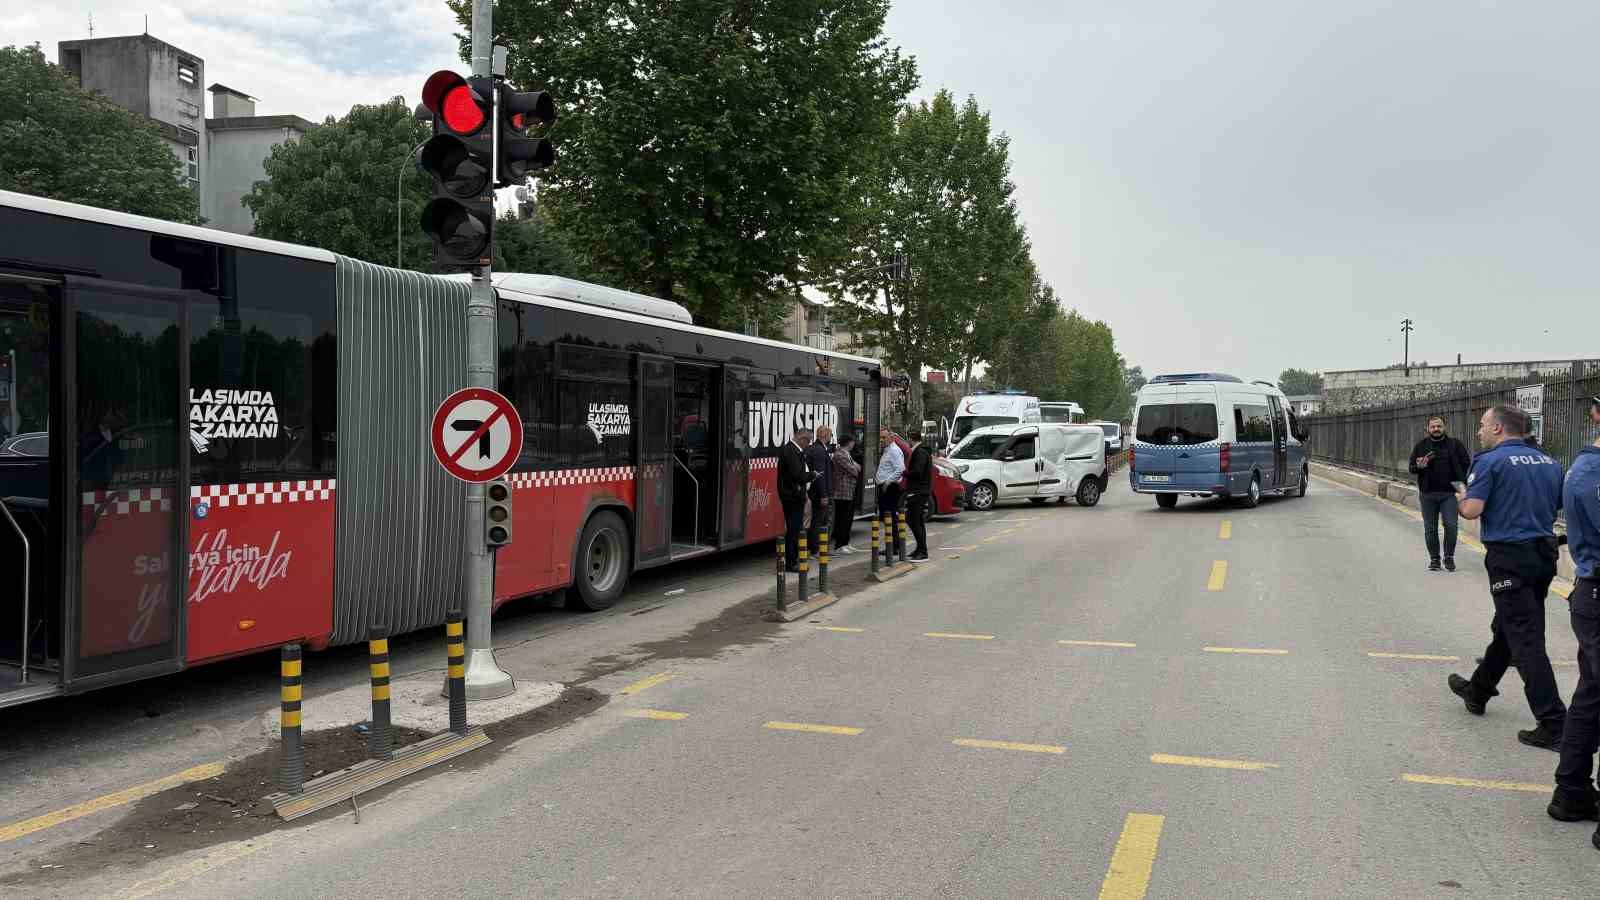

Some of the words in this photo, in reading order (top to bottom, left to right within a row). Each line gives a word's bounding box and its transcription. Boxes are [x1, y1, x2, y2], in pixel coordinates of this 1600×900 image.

[190, 405, 279, 422] AKARYA
[201, 422, 279, 438] ZAMANI
[599, 424, 631, 436] ZAMANI
